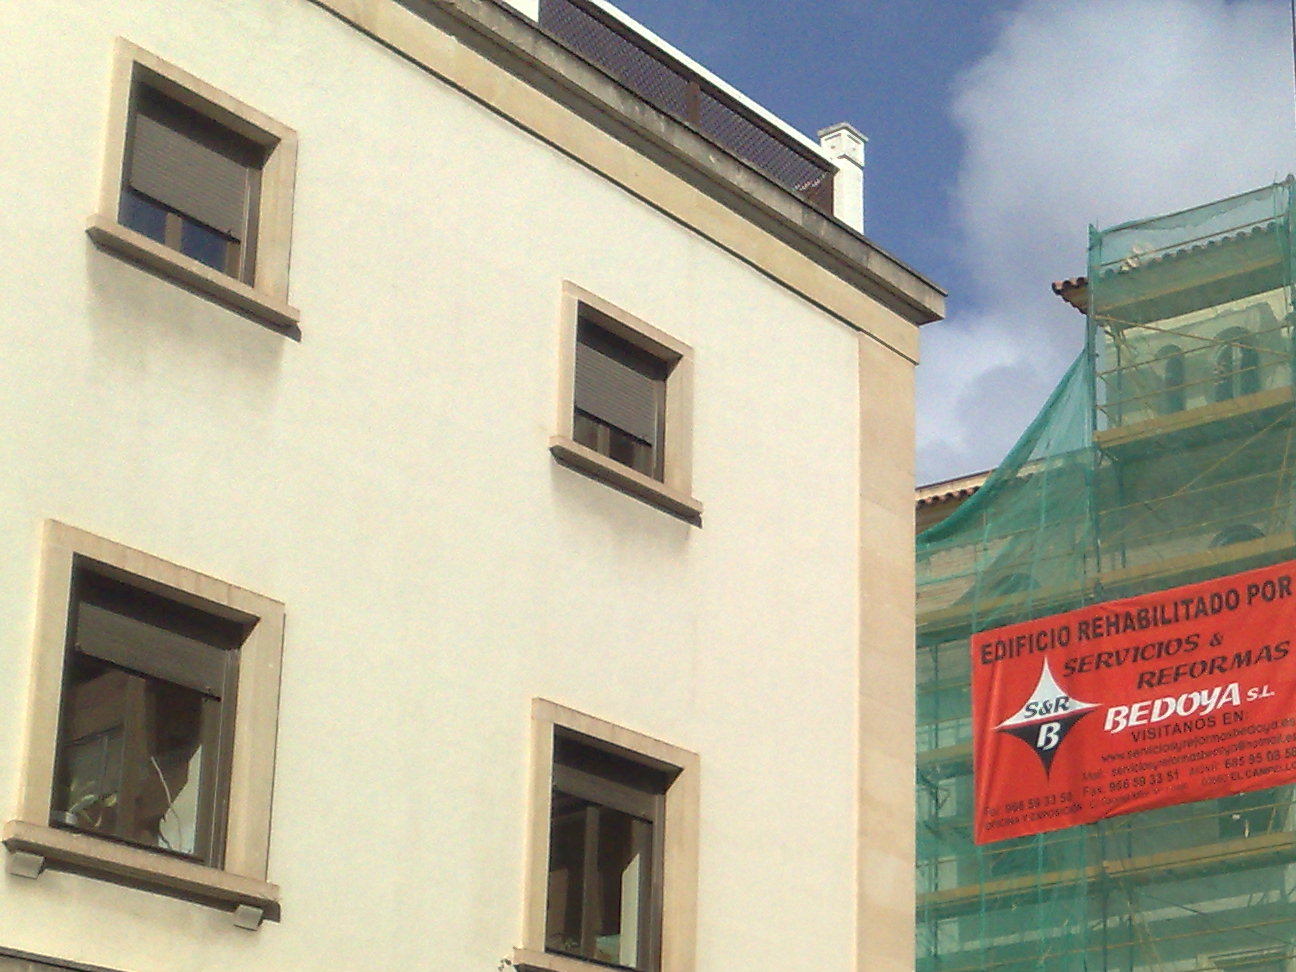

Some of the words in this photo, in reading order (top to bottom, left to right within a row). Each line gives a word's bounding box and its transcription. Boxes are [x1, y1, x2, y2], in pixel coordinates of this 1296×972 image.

[981, 626, 1070, 665] EDIFICIO
[1077, 589, 1240, 642] REHABILITADO
[1247, 576, 1293, 606] POR
[1063, 633, 1200, 677] SERVICIOS
[1209, 632, 1224, 647] &
[1137, 641, 1290, 690] REFORMAS
[1024, 696, 1071, 719] S&R
[1104, 682, 1241, 733] BEDOYA
[1131, 717, 1216, 743] VISITANOS
[1036, 722, 1061, 751] B
